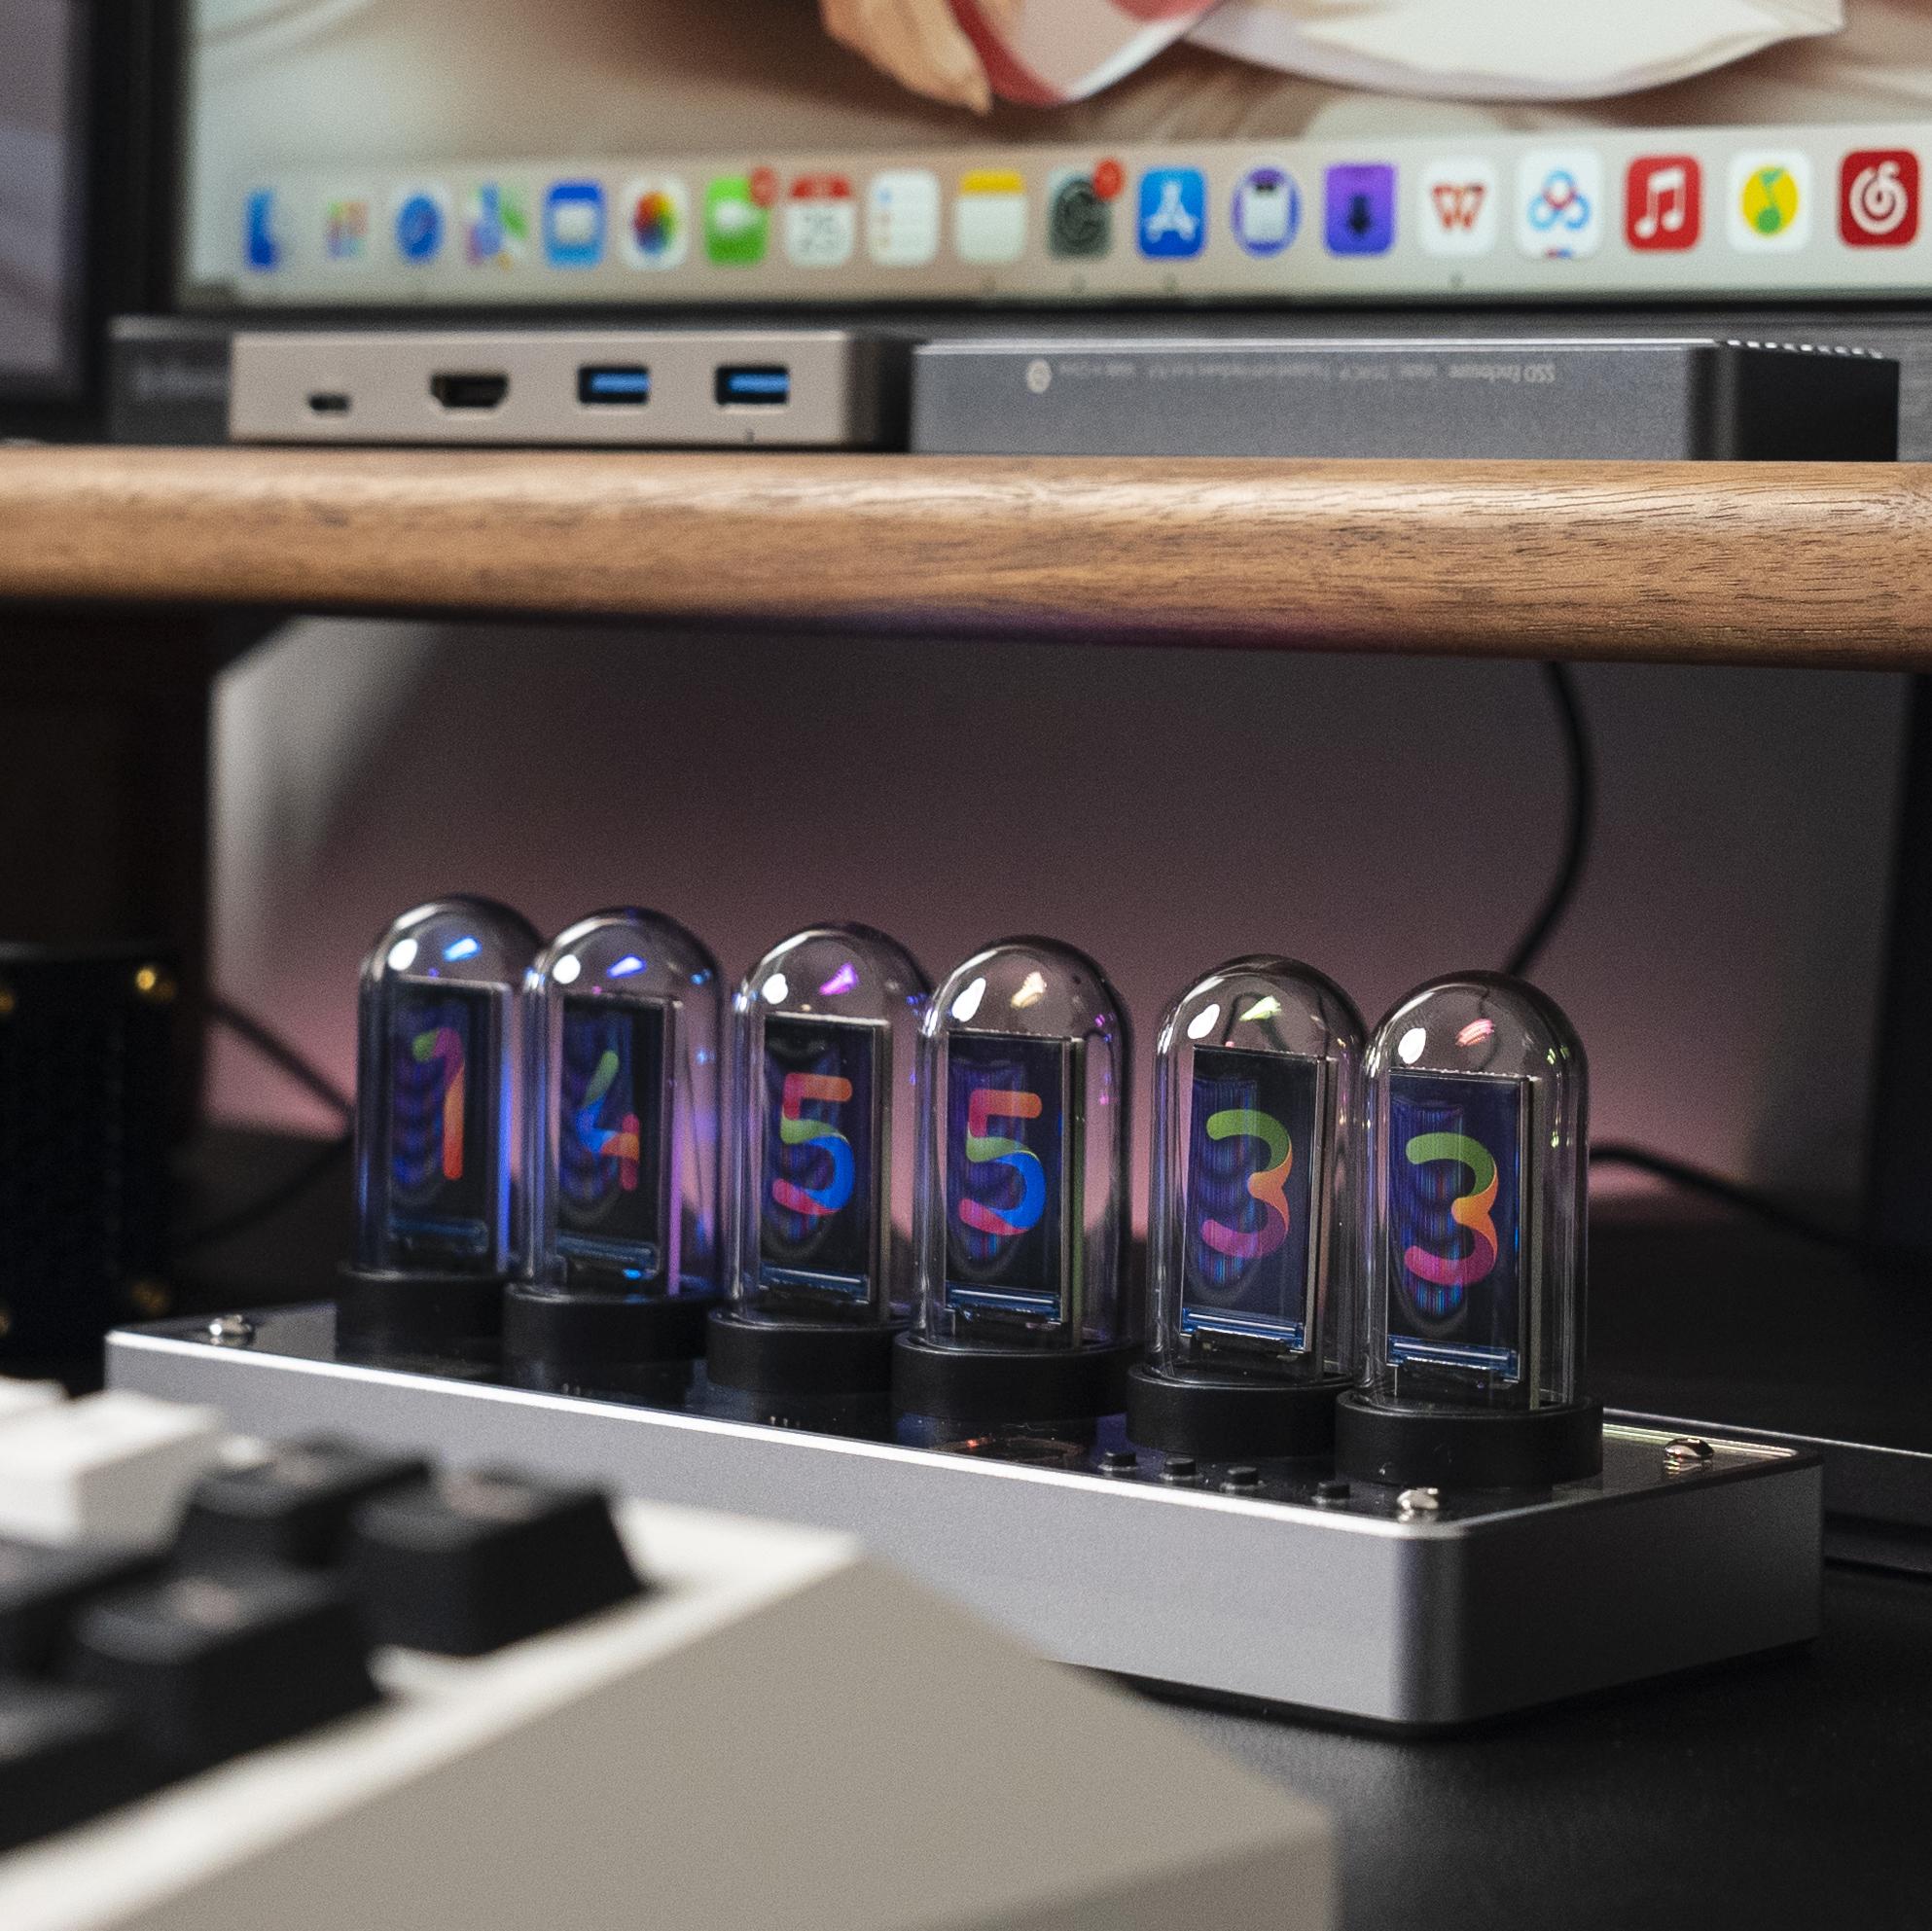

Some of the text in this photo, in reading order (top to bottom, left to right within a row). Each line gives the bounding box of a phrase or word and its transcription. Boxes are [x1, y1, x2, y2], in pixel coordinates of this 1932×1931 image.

[1523, 364, 1556, 383] SSD
[411, 1027, 1499, 1287] 1 4 5 5 3 3
